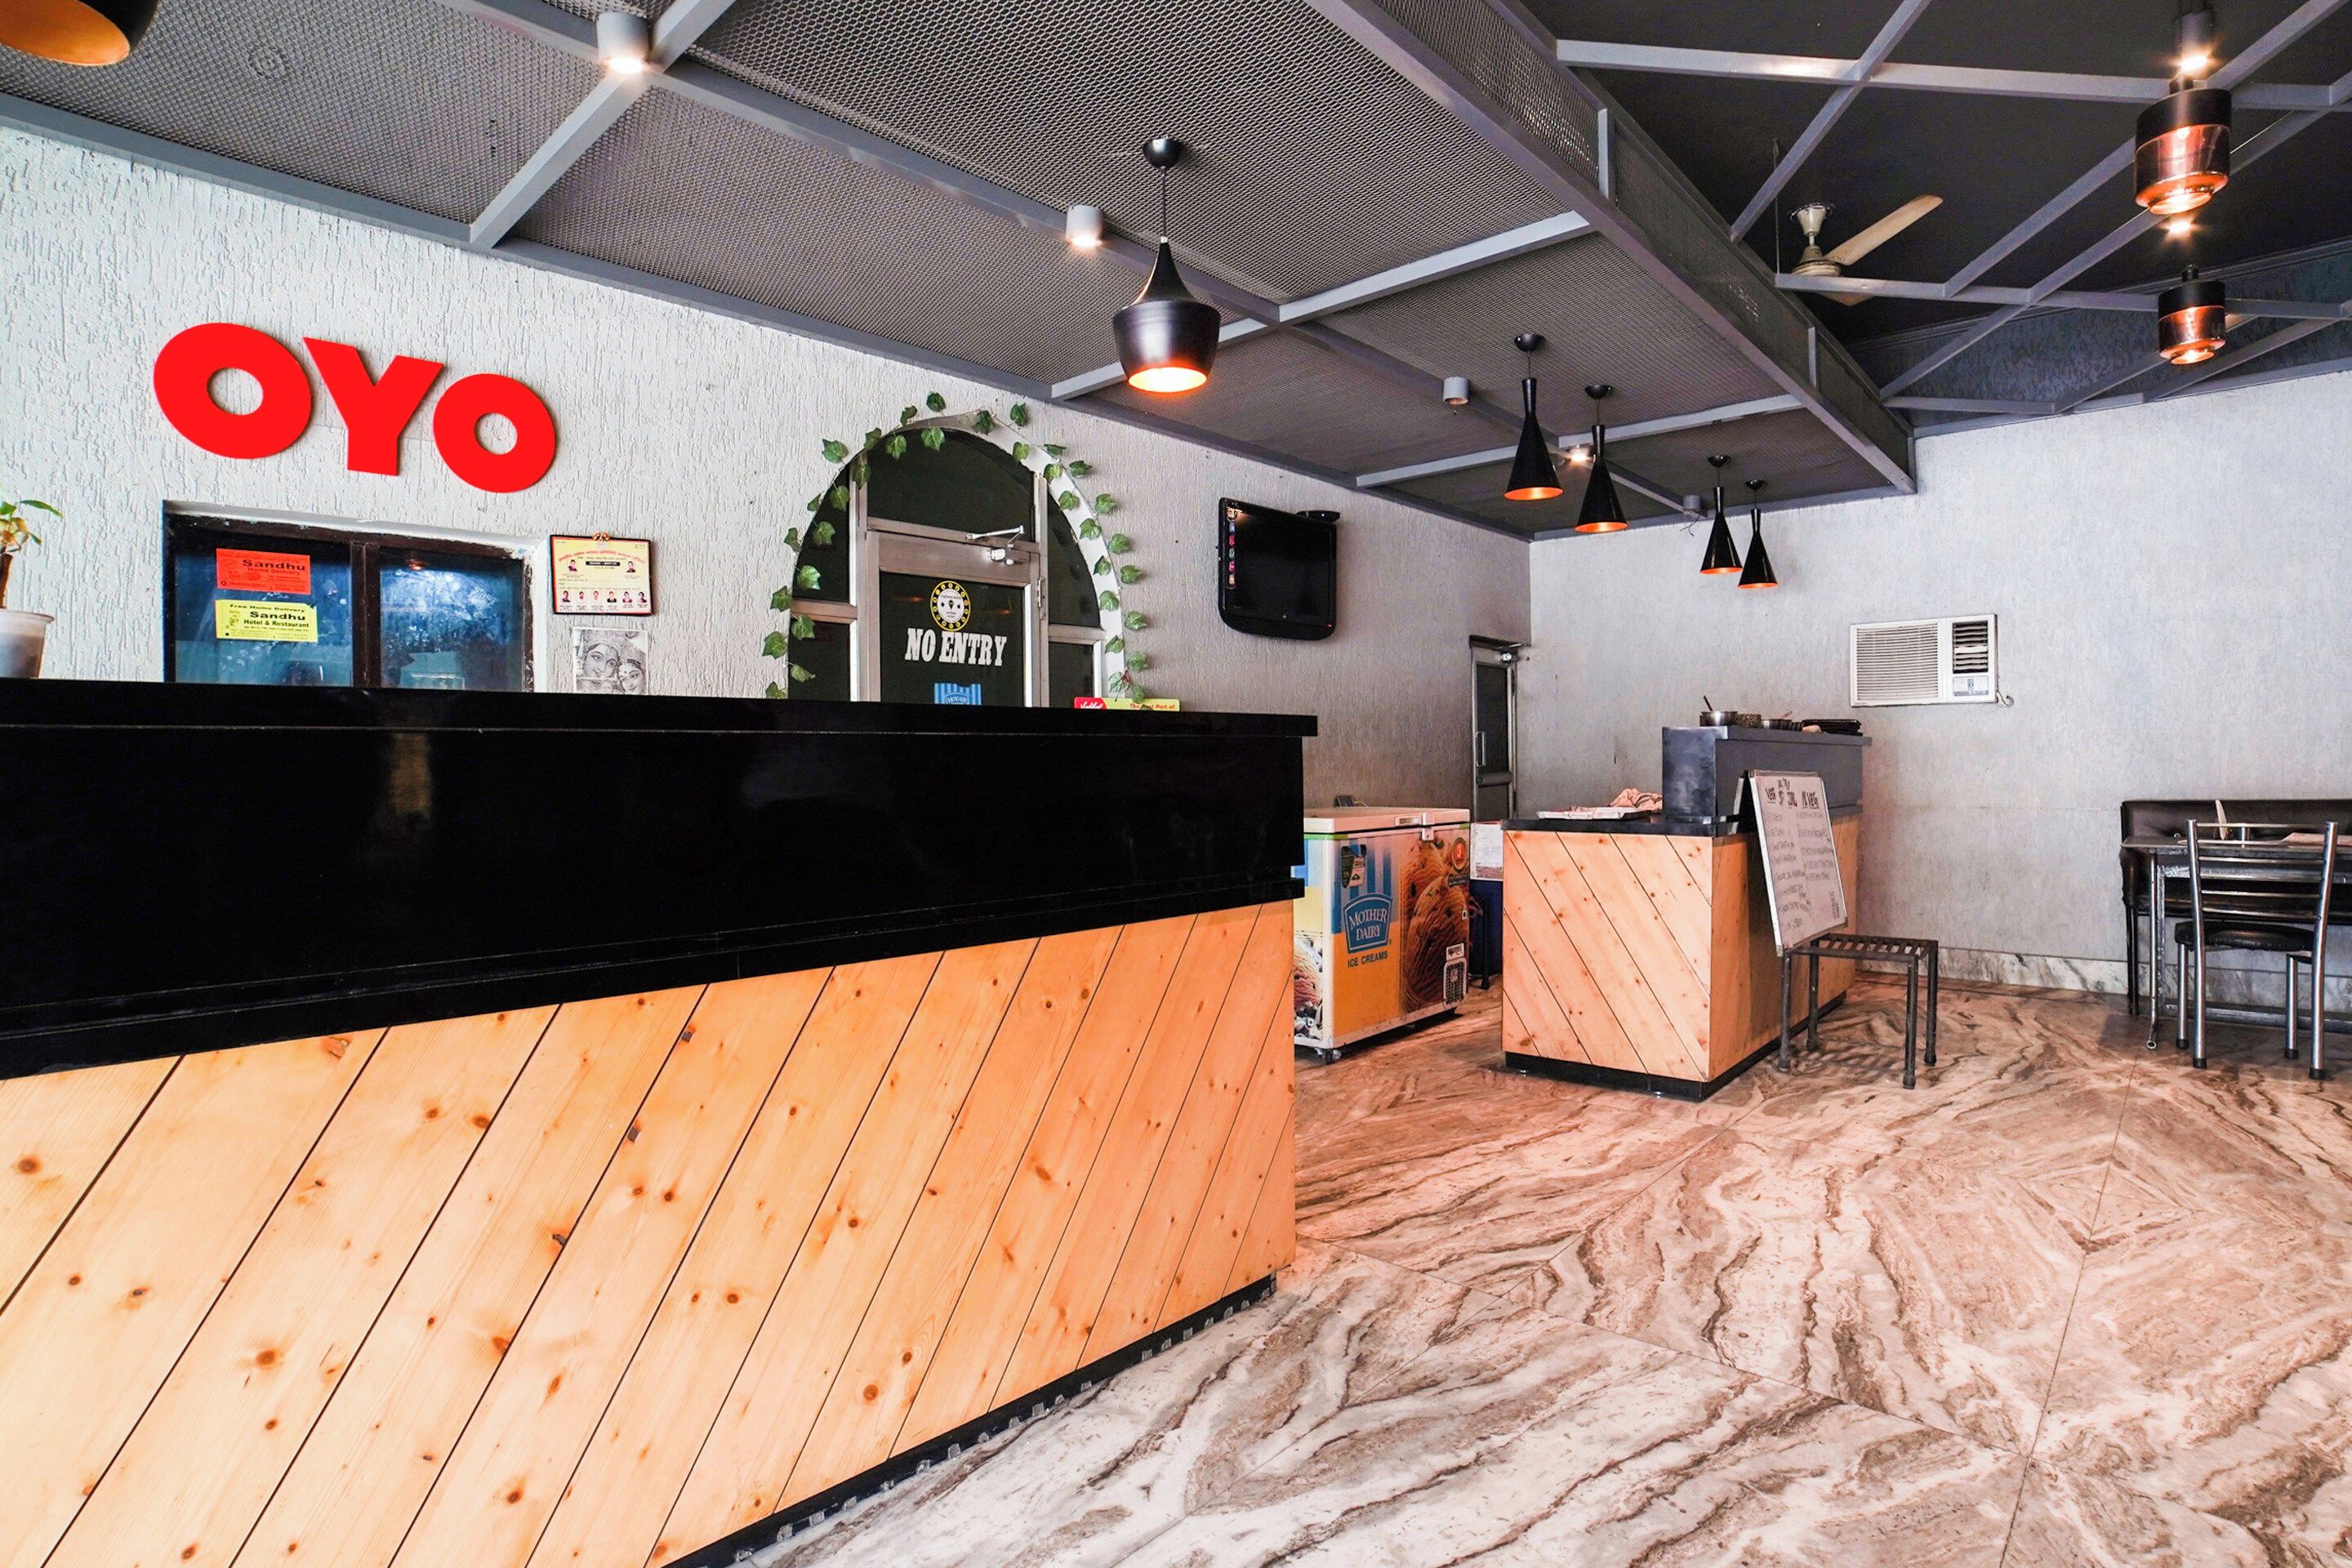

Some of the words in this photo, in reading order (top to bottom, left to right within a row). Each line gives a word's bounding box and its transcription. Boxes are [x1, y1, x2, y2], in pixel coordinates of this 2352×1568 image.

[154, 322, 556, 493] OYO
[242, 559, 305, 571] Sandhu
[250, 611, 306, 621] Sandhu
[904, 627, 936, 662] NO
[938, 630, 1007, 666] ENTRY
[1348, 908, 1388, 929] MOTHER
[1356, 924, 1382, 941] DAIRY
[1348, 956, 1359, 968] ICE
[1361, 951, 1388, 964] CREAMS
